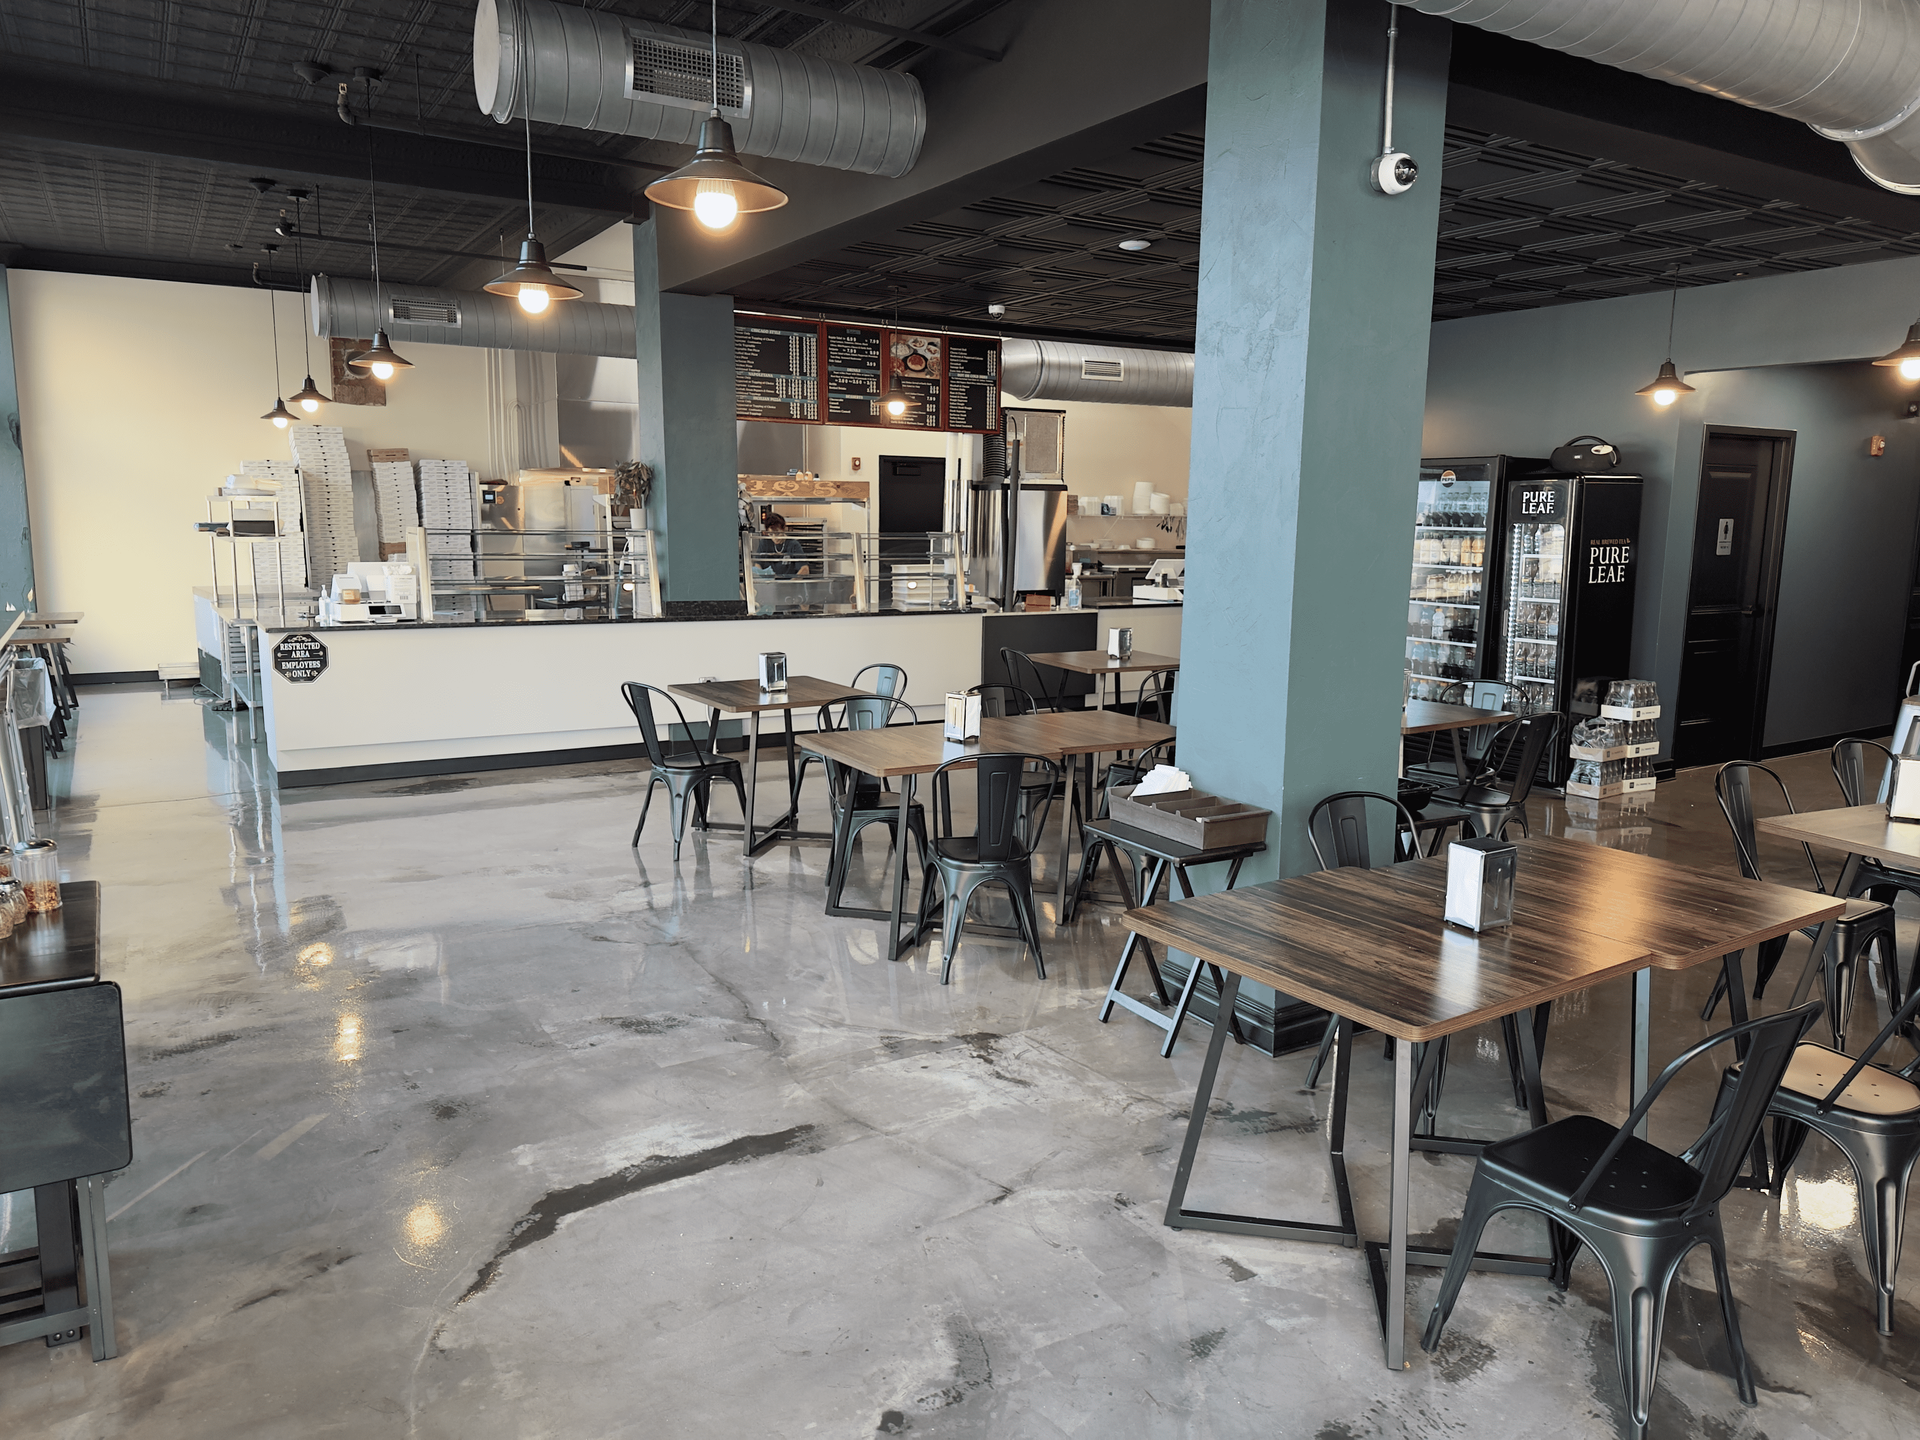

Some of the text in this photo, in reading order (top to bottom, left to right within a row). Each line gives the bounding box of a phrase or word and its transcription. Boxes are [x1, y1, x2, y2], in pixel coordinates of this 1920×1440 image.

[1522, 491, 1555, 503] PURE
[1589, 546, 1630, 565] PURE
[280, 642, 320, 650] RESTRICTED
[281, 661, 320, 669] EMPLOYEES
